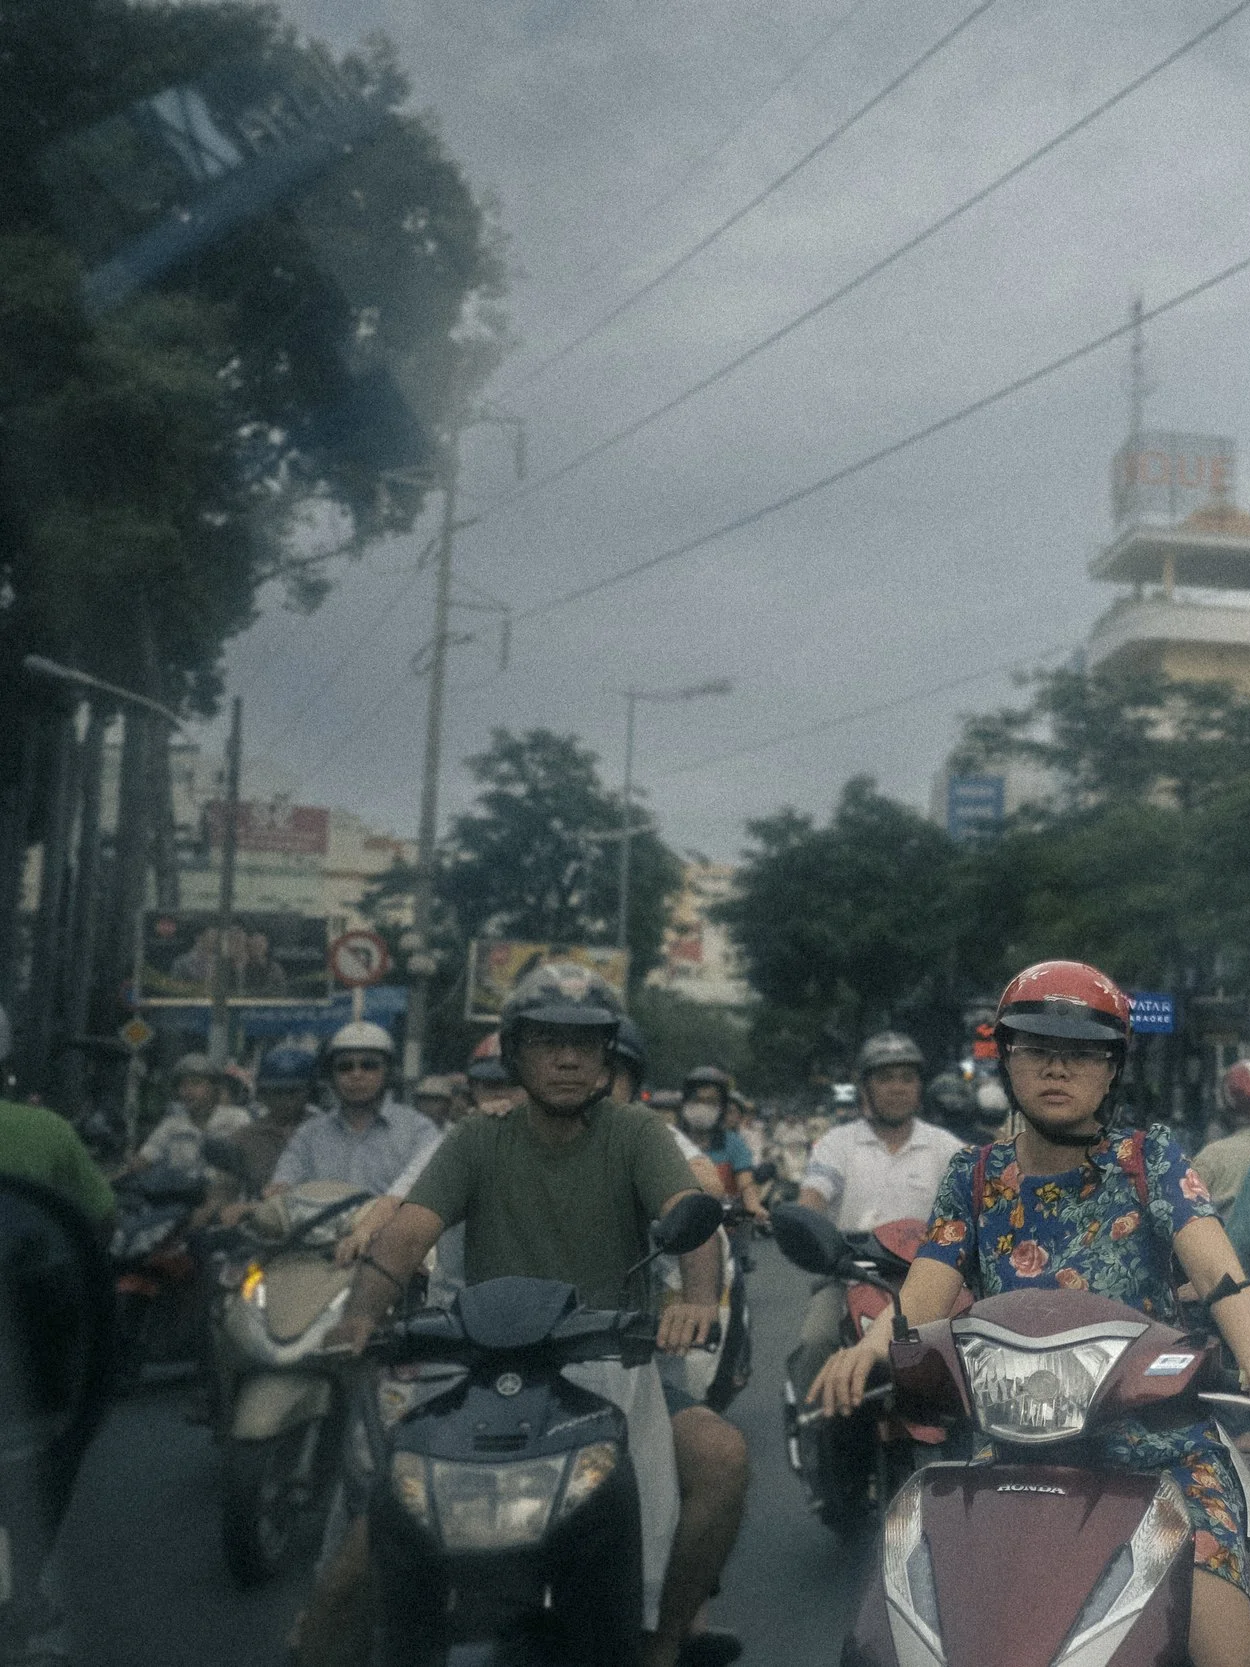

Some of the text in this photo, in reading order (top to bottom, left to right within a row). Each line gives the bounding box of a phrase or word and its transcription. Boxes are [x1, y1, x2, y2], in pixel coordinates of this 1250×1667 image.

[1128, 999, 1171, 1012] VATAR
[1129, 1015, 1170, 1023] ARAOKE
[996, 1484, 1066, 1495] HONDA
